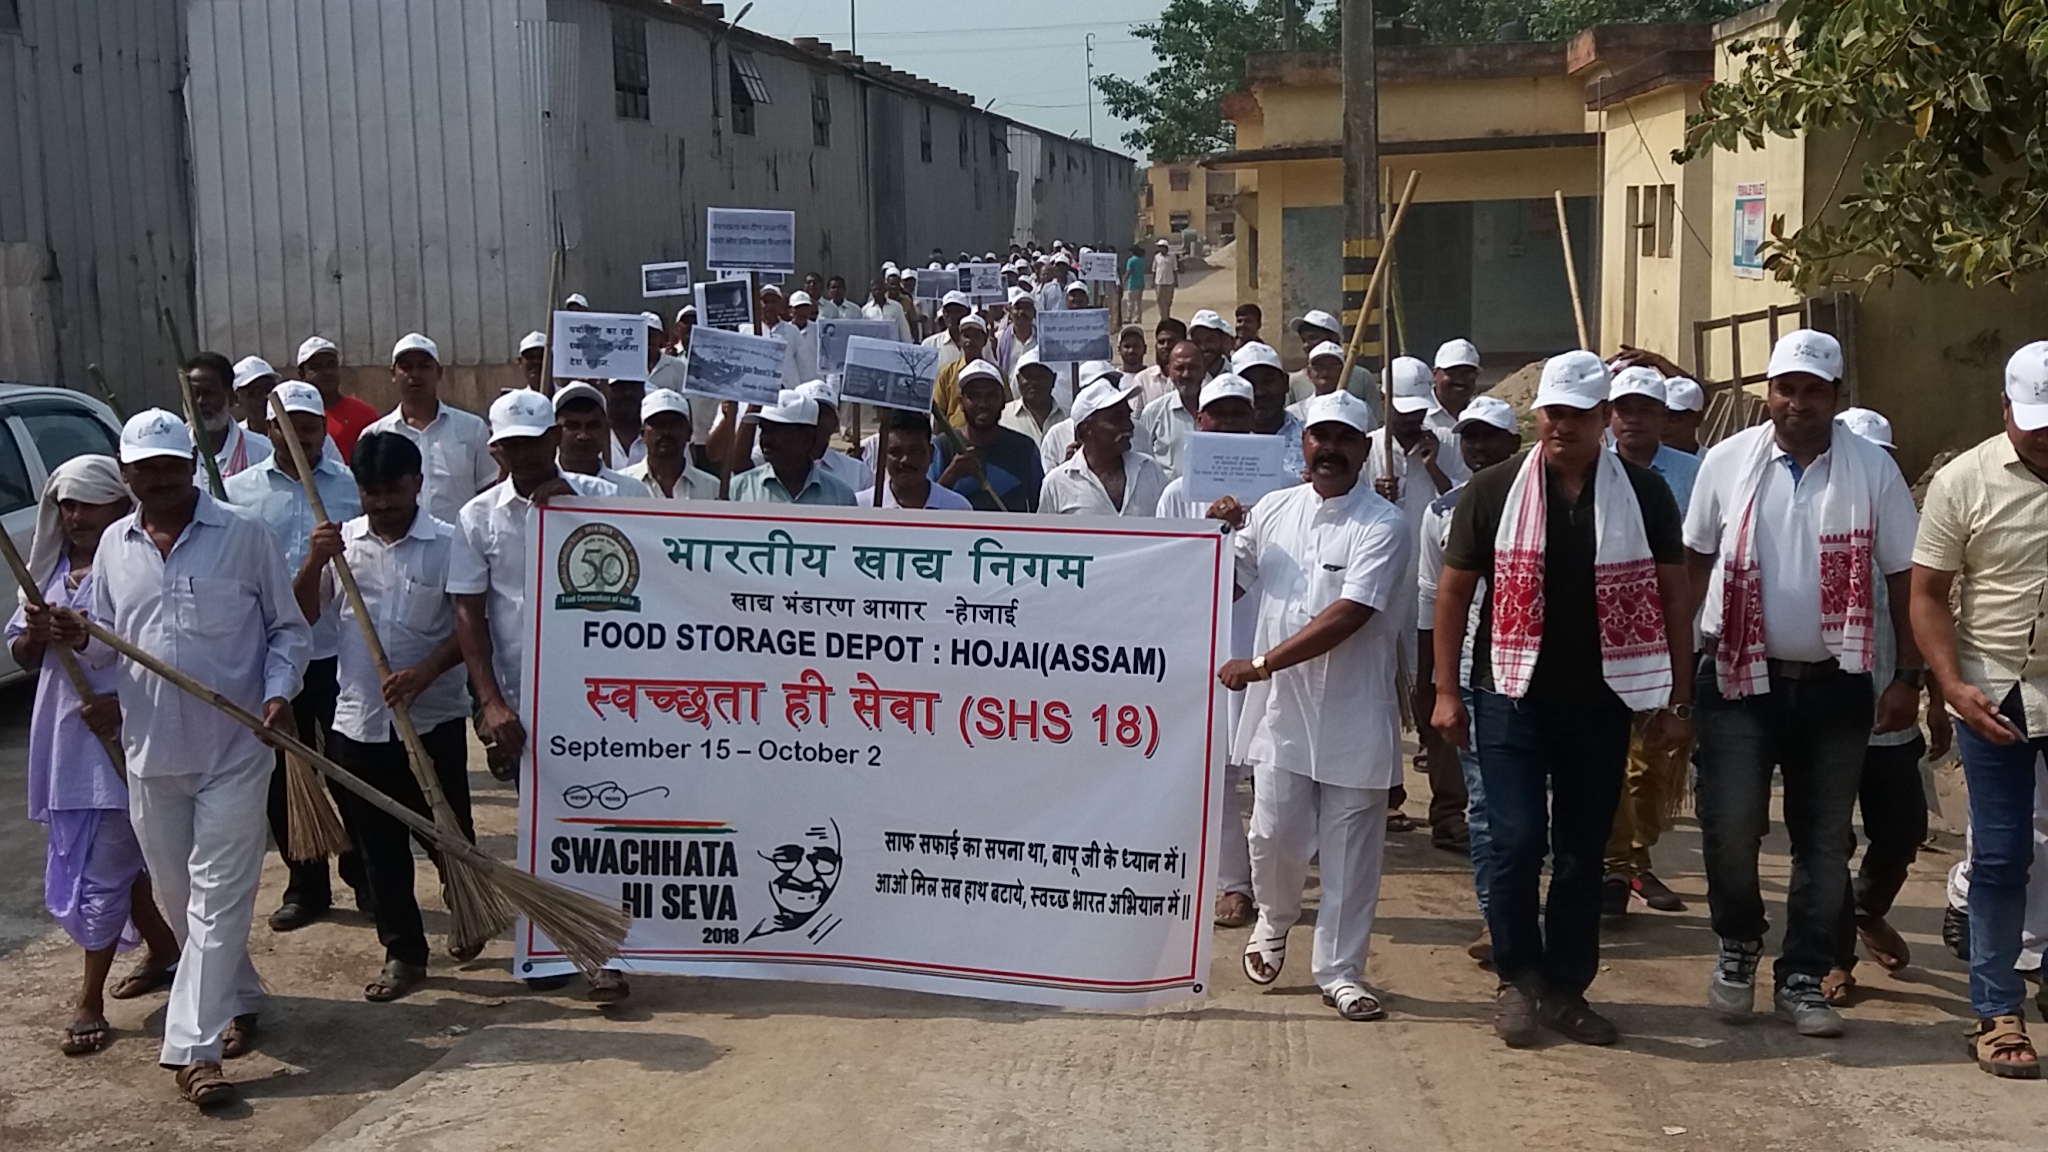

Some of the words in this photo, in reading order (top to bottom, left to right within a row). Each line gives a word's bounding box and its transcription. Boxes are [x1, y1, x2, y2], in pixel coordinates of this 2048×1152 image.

[662, 529, 837, 578] भारतीय
[852, 545, 953, 583] खाद्य
[967, 537, 1094, 589] निगम
[730, 592, 775, 613] खाद्य
[862, 599, 928, 622] आगार
[583, 620, 667, 650] FOOD
[676, 623, 817, 657] STORAGE
[826, 631, 924, 663] DEPOT
[584, 677, 768, 731] स्वच्छता
[781, 668, 836, 733] ही
[849, 672, 943, 736] सेवा
[959, 695, 1073, 749] (SHS
[1091, 703, 1160, 760] 18)
[550, 735, 692, 763] September
[700, 738, 731, 760] 15
[758, 739, 860, 765] October
[867, 745, 882, 767] 2
[550, 836, 739, 878] SWACHHATA
[884, 831, 917, 853] साफ
[918, 828, 961, 861] सफाई
[962, 836, 983, 859] का
[984, 838, 1026, 862] सपना
[1052, 844, 1081, 878] बापू
[1081, 840, 1102, 869] जी
[1103, 842, 1120, 870] के
[1121, 847, 1162, 874] ध्यान
[621, 881, 653, 919] HI
[661, 883, 738, 921] SEVA
[875, 868, 909, 895] आओ
[910, 868, 939, 898] मिल
[940, 877, 963, 900] सब
[964, 879, 989, 905] हाथ
[1030, 886, 1071, 910] स्वच्छ
[1072, 888, 1108, 914] भारत
[1108, 886, 1166, 916] अभियान
[702, 927, 740, 945] 2018
